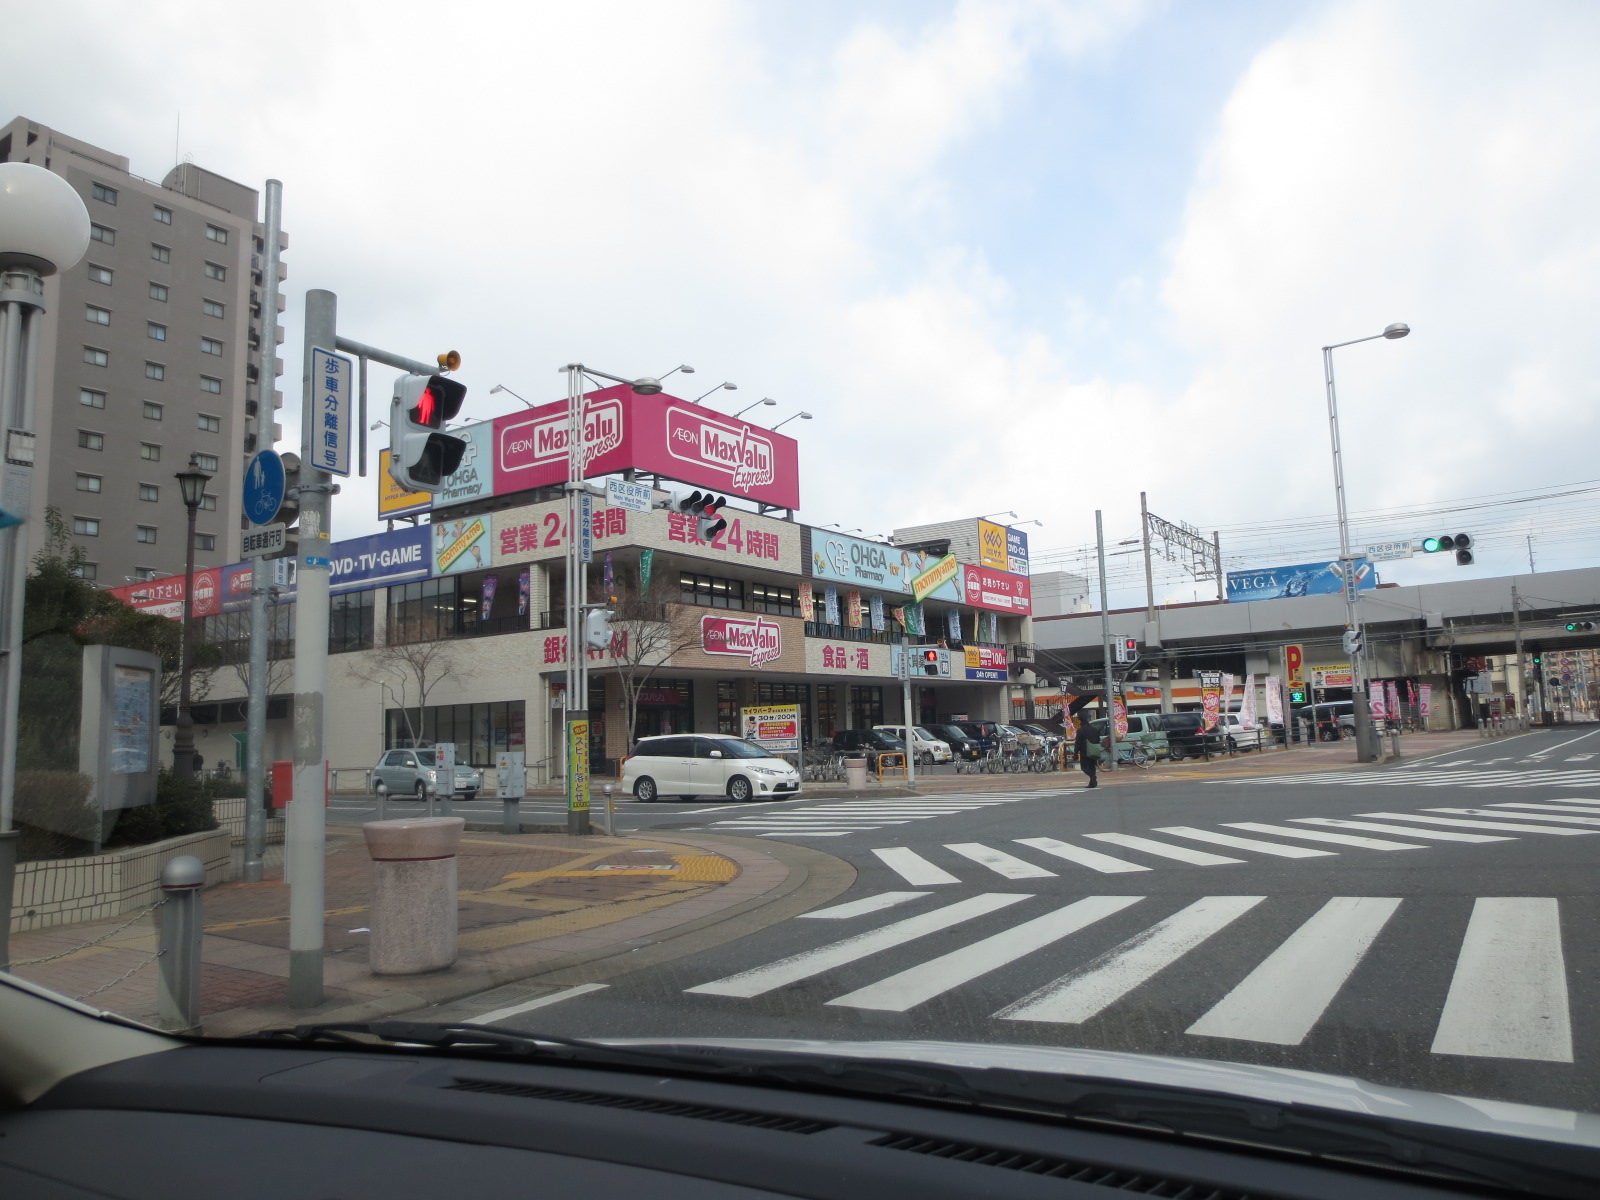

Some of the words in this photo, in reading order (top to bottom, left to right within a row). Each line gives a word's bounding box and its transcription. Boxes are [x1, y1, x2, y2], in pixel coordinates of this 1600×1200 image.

[324, 356, 339, 467] 歩車分離信号
[705, 427, 767, 470] MaxValu
[442, 482, 483, 500] Pharmacy
[446, 470, 478, 488] OHGA
[609, 481, 651, 500] 西区役所前
[733, 464, 770, 493] Express
[499, 507, 627, 556] 営業2時間
[582, 497, 590, 559] 歩車分離信号
[1008, 533, 1021, 545] GAME
[243, 529, 282, 553] 自転車通行可
[1368, 541, 1410, 554] 西区役所前
[850, 543, 887, 571] OHGA
[889, 561, 900, 576] for
[854, 565, 885, 585] Pharmacy
[1229, 575, 1278, 591] VEGA
[728, 617, 776, 649] MaxValu
[750, 646, 779, 667] Express
[822, 644, 869, 671] 食品・酒
[1287, 646, 1302, 681] P
[1292, 692, 1303, 702] 空
[574, 736, 584, 801] スピード落とせ
